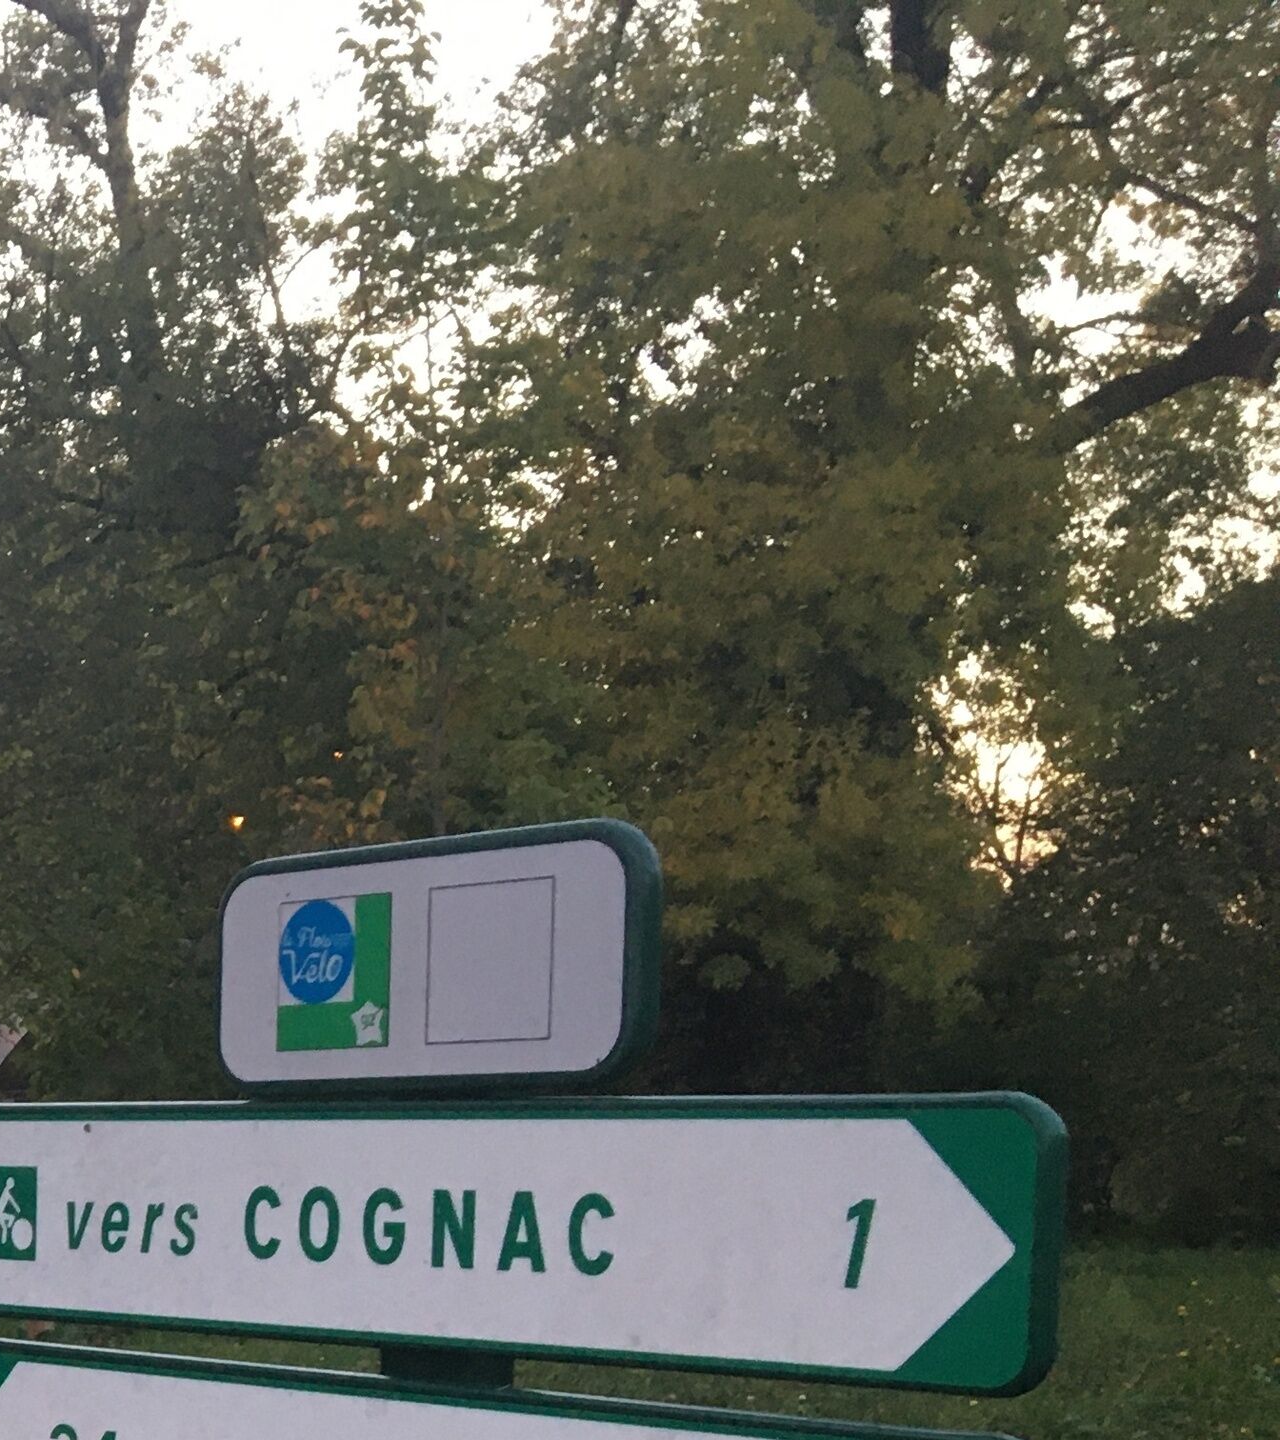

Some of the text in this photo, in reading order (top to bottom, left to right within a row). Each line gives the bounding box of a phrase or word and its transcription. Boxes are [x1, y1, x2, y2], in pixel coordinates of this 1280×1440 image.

[64, 1183, 878, 1290] vers COGNAC 1
